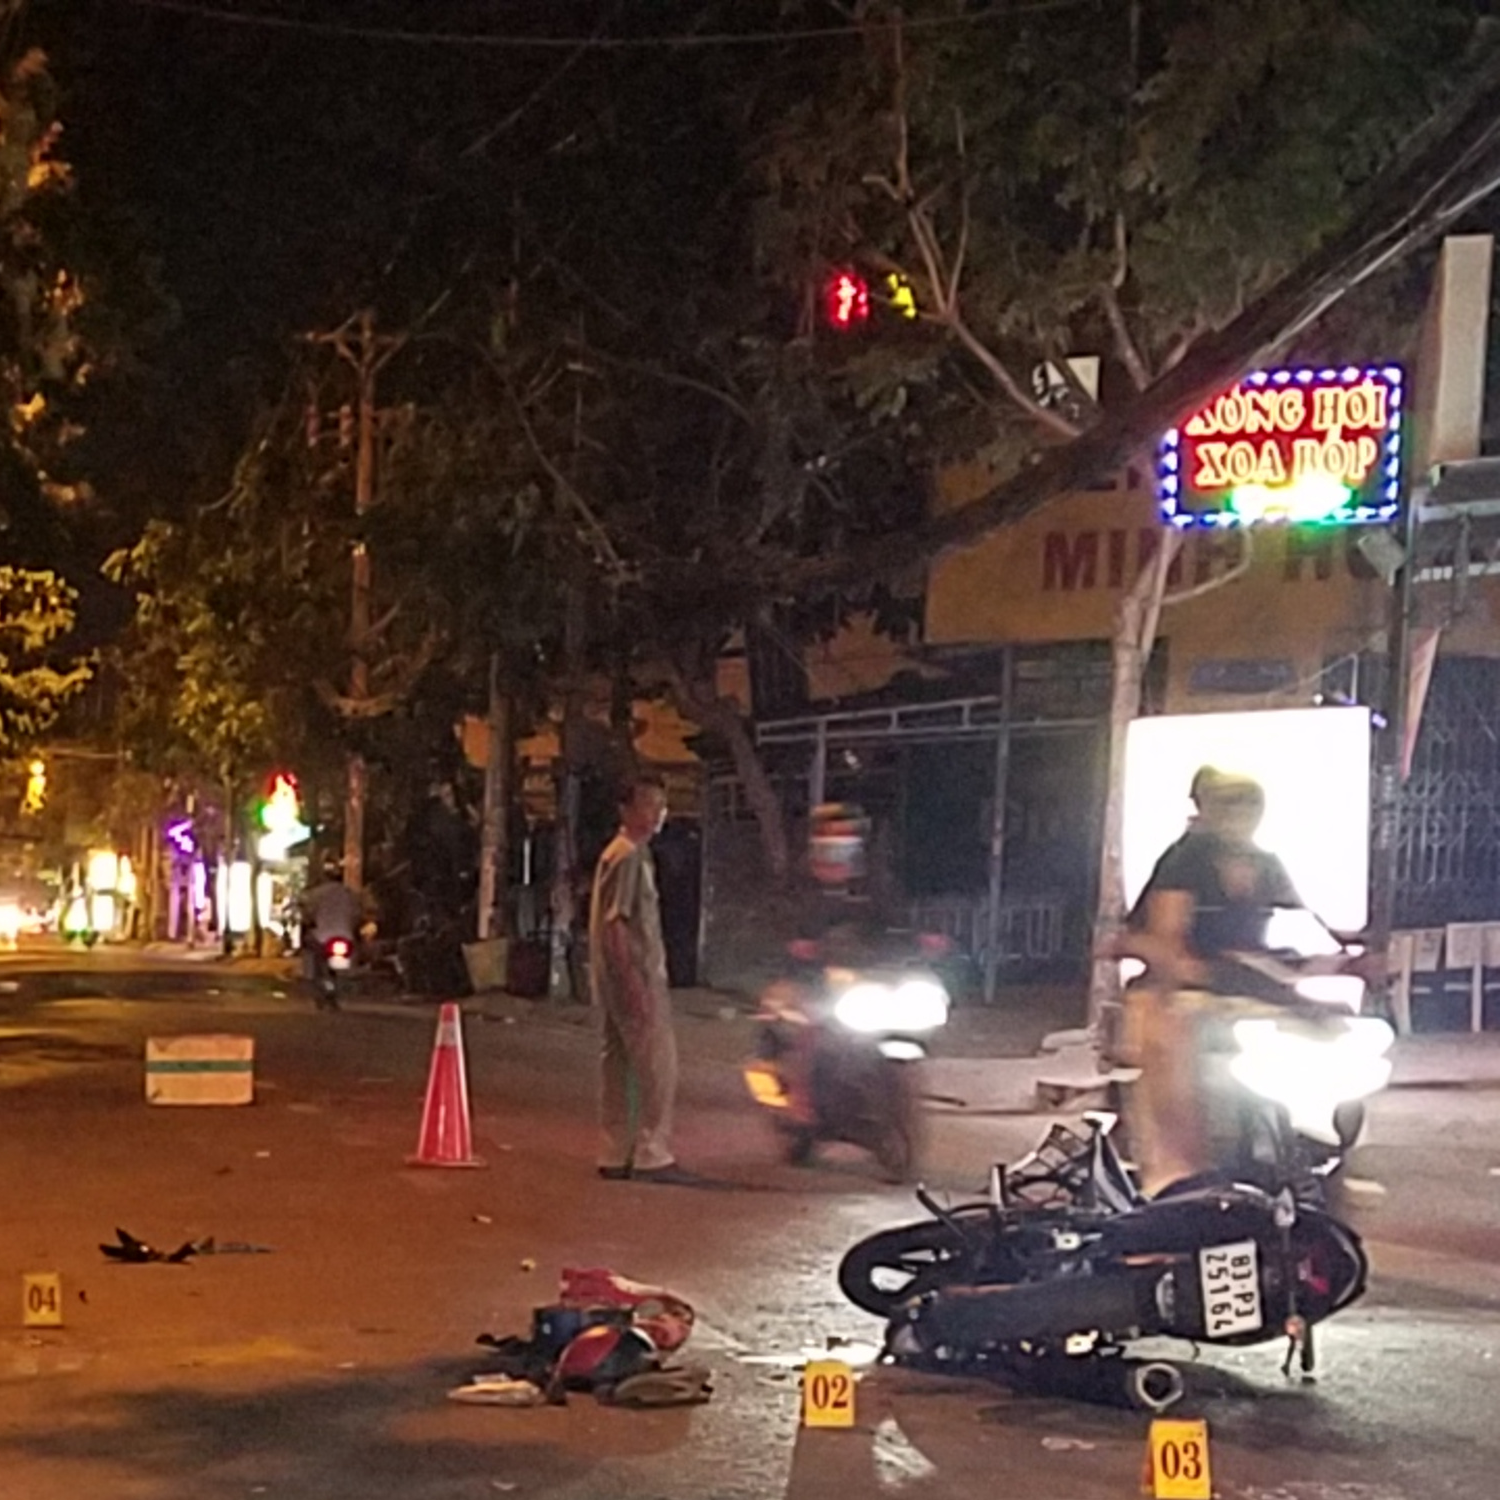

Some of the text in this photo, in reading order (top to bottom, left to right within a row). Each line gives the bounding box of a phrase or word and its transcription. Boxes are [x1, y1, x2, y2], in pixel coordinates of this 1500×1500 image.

[28, 1284, 56, 1313] 04
[812, 1374, 848, 1409] 02
[1161, 1441, 1202, 1479] 03
